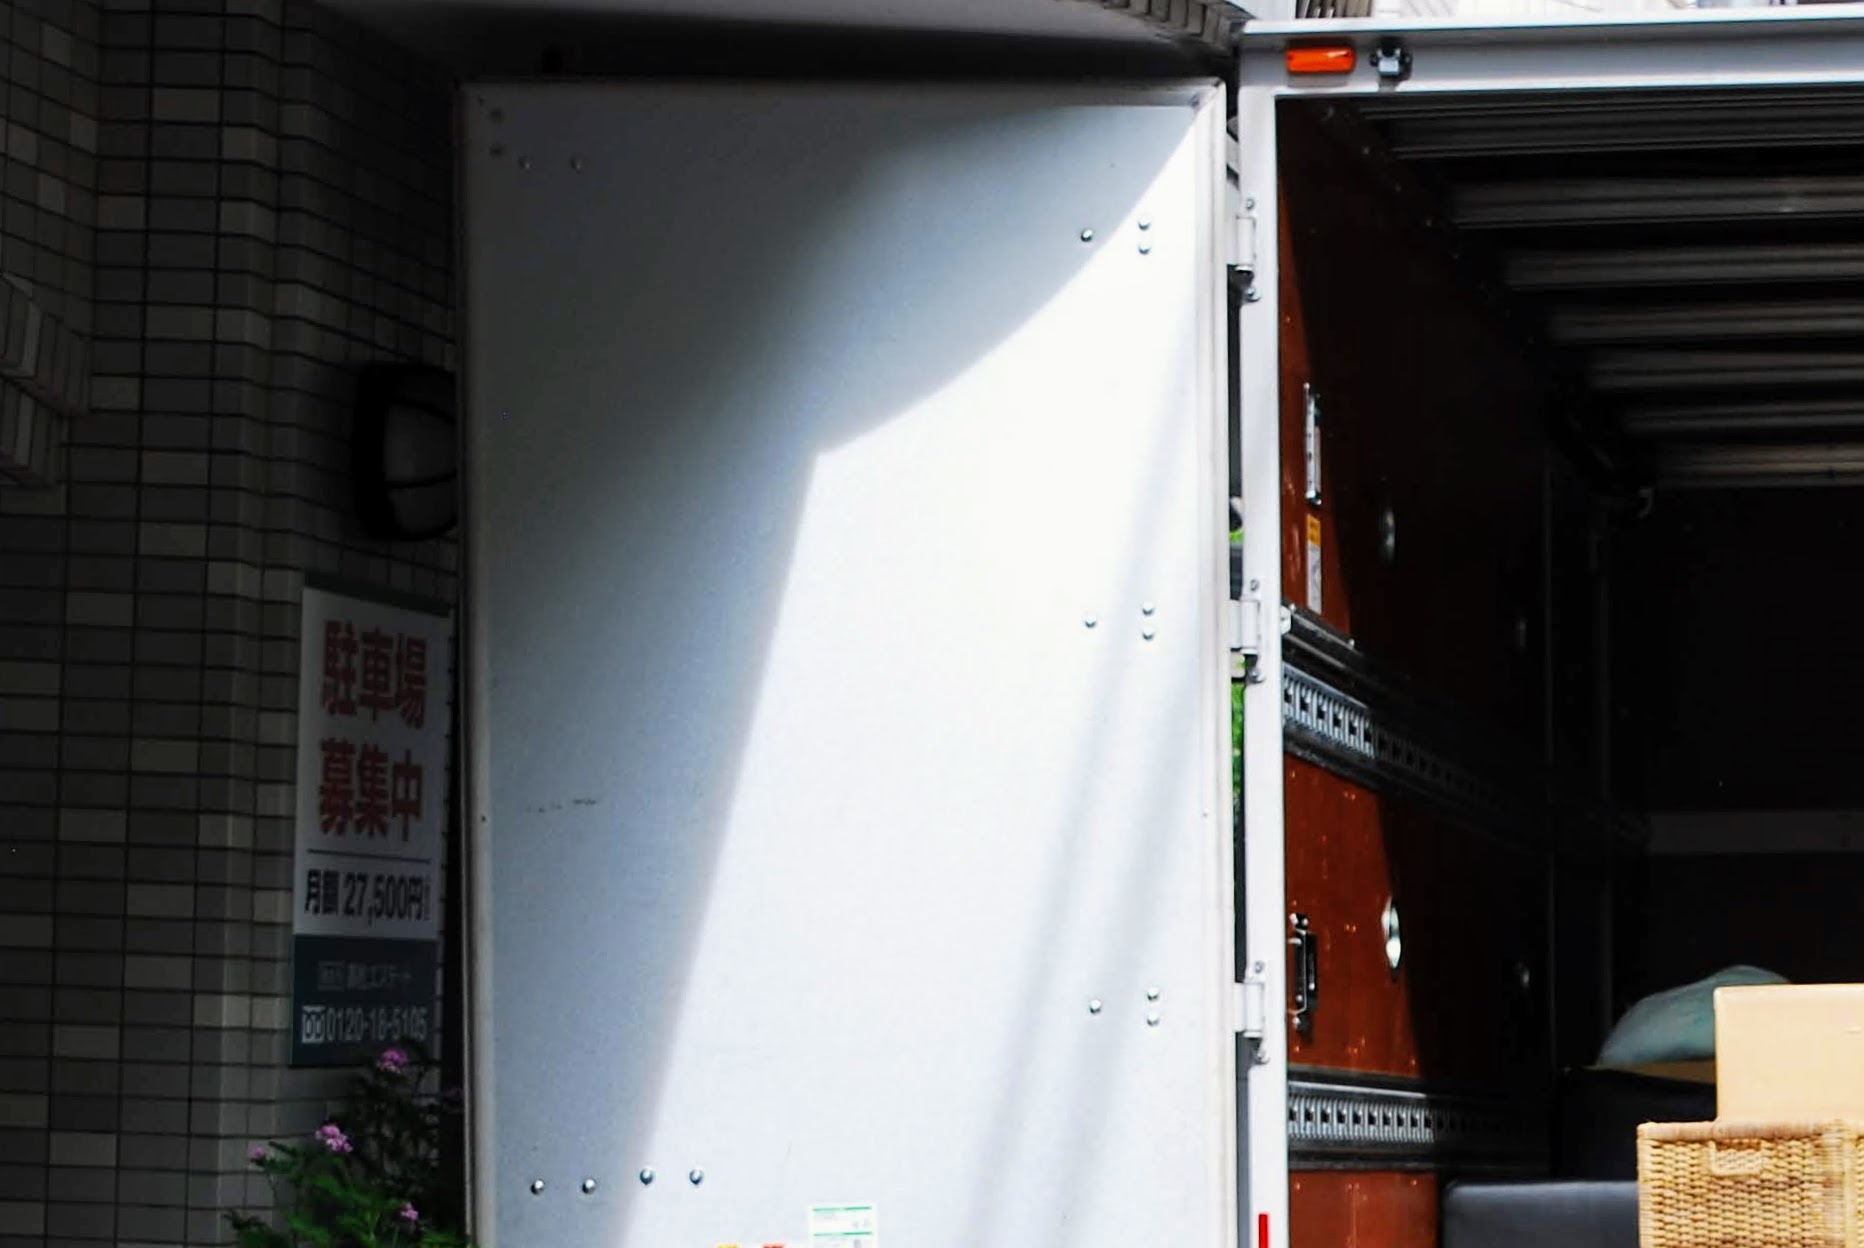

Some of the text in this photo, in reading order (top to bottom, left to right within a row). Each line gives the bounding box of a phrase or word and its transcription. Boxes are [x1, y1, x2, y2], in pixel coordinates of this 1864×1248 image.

[321, 620, 427, 729] 駐車場
[319, 737, 424, 842] 募集中
